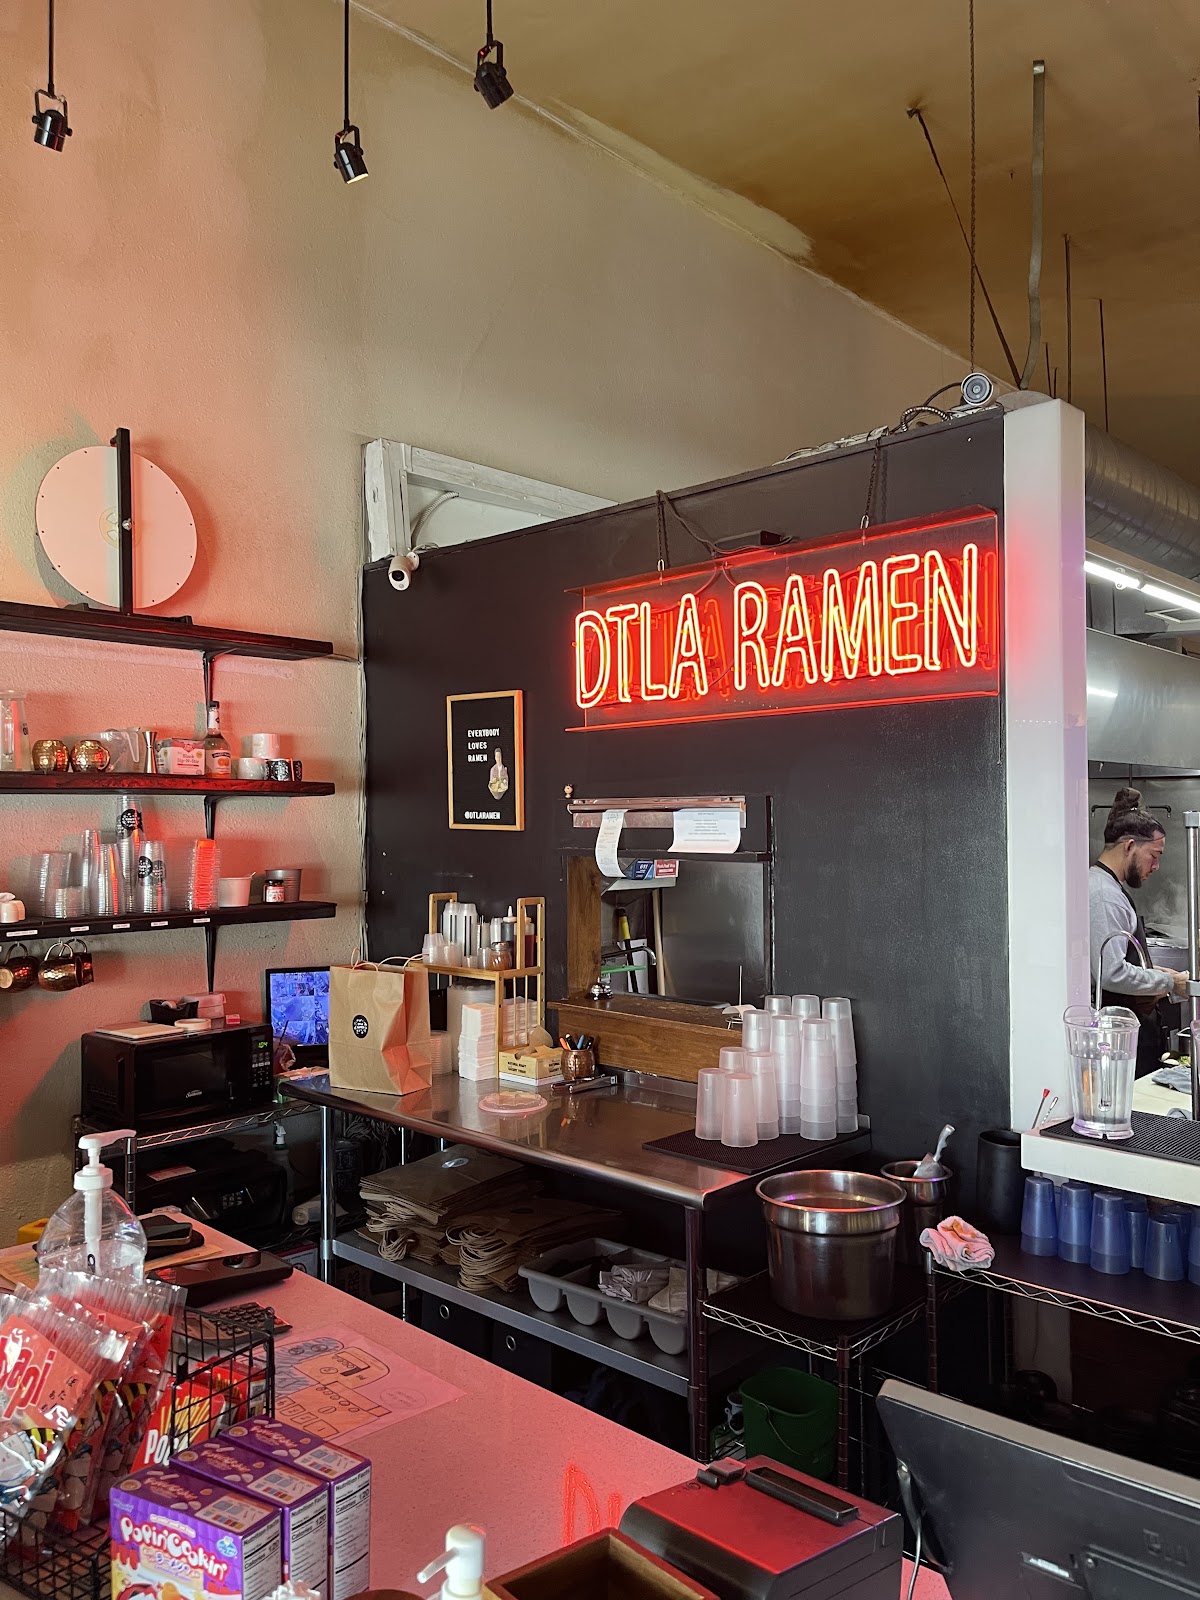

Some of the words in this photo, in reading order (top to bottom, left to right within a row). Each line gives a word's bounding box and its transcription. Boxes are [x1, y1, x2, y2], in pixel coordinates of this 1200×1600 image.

[575, 593, 708, 709] DTLA
[733, 543, 978, 692] RAMEN
[467, 728, 500, 738] EVERYBODY
[468, 742, 488, 750] LOVES
[467, 754, 488, 762] RAMEN
[464, 811, 501, 820] @DTLARAMEN
